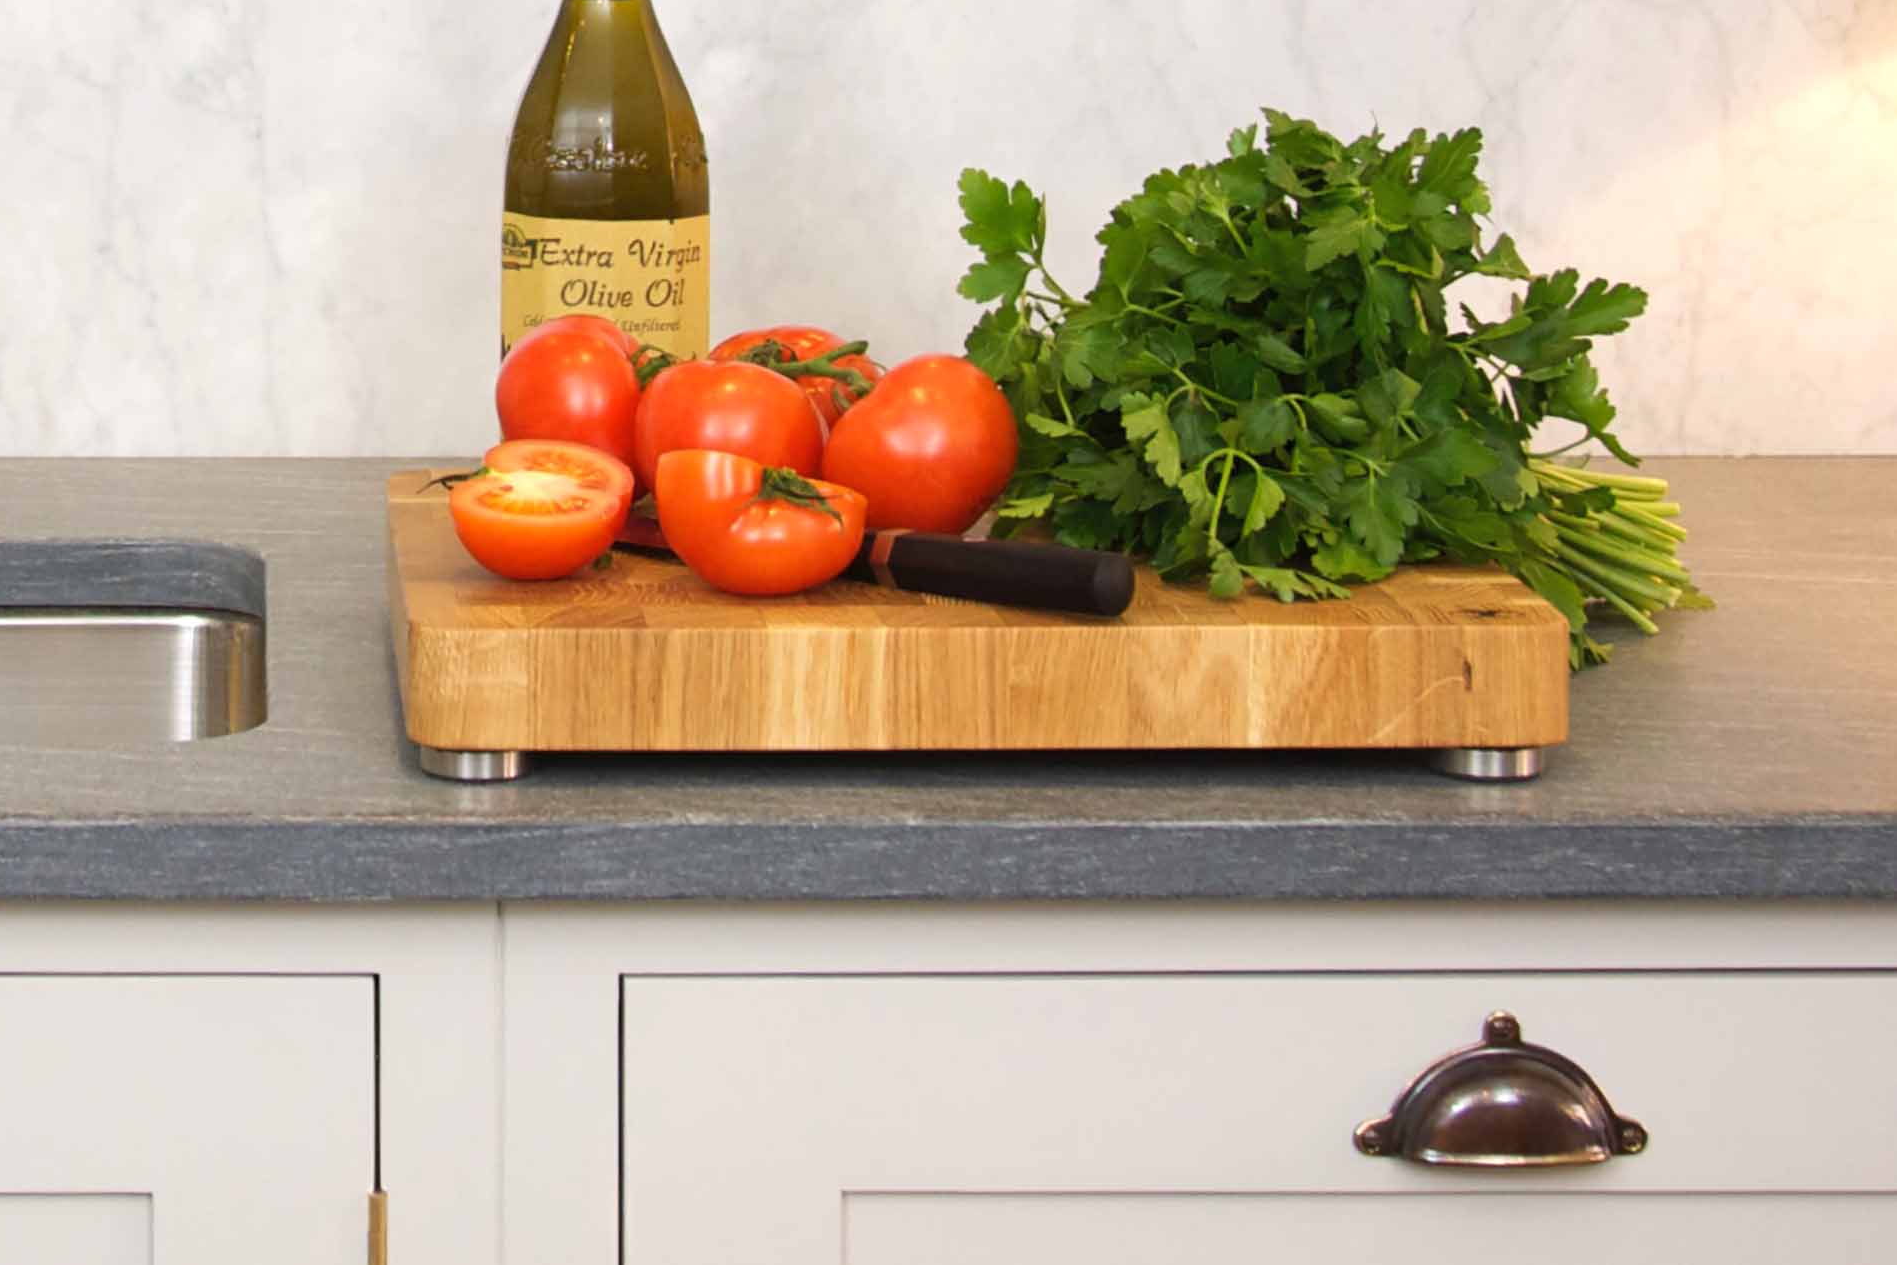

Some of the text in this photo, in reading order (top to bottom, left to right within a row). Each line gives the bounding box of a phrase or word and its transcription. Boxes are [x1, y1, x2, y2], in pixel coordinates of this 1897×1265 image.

[540, 239, 613, 267] Extra
[628, 240, 701, 271] Virgin
[560, 279, 685, 307] Olive Oil
